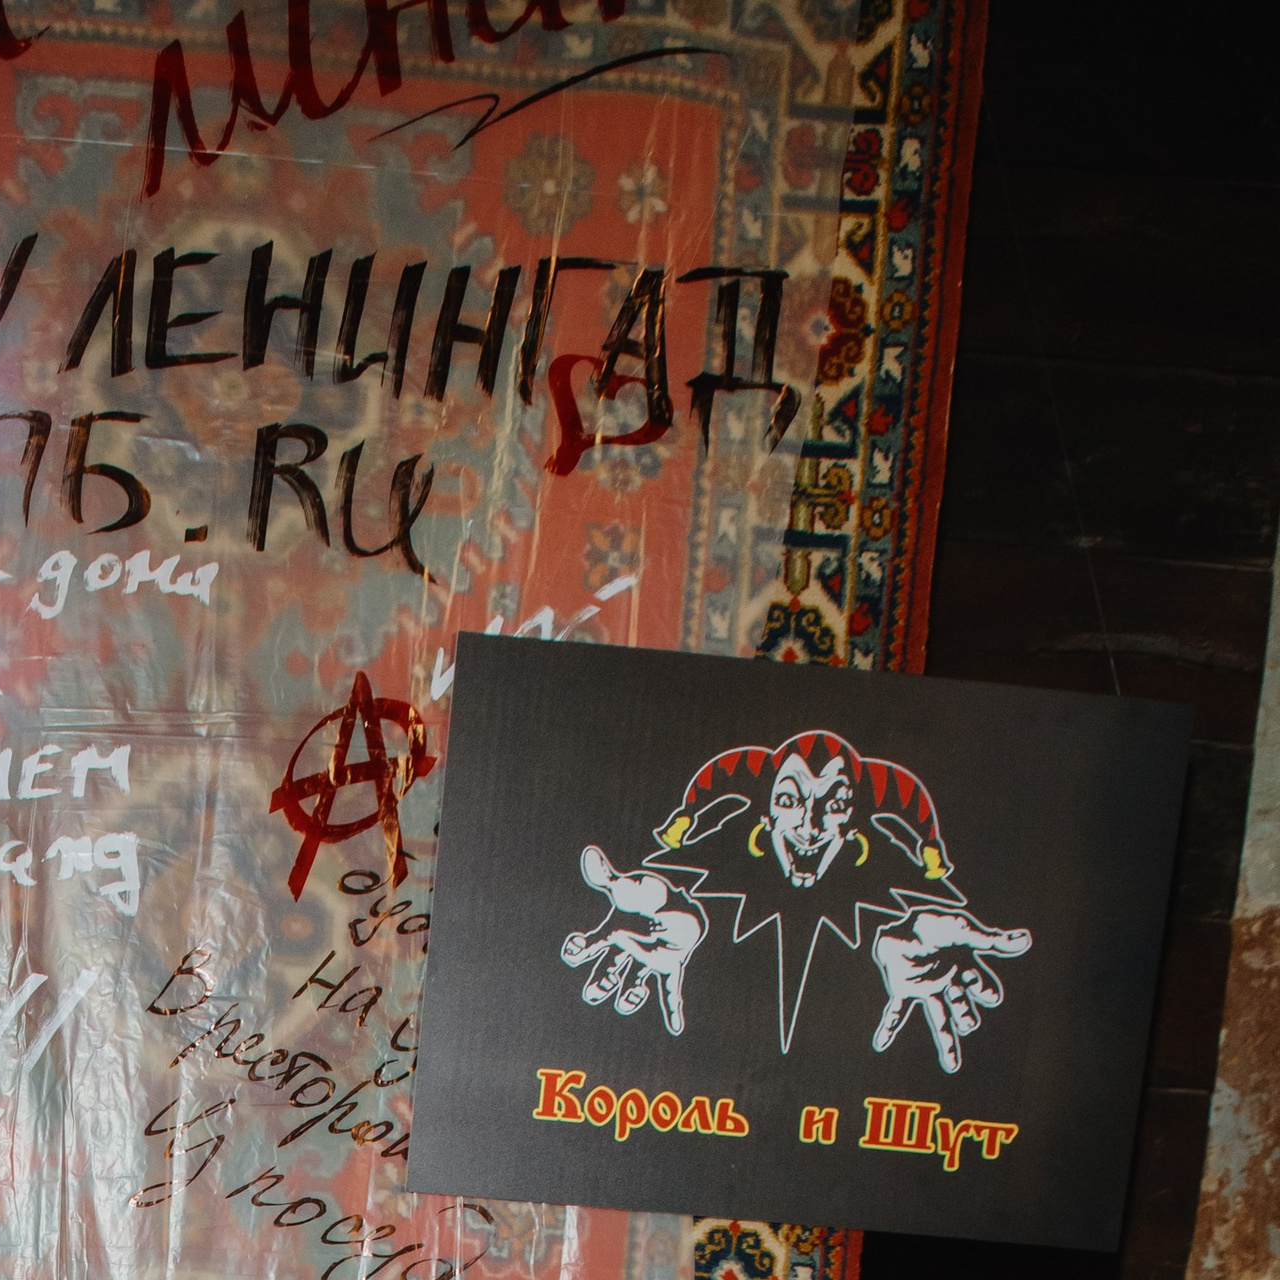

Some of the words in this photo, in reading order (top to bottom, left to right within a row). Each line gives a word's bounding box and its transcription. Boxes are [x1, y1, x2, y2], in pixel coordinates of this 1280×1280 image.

[532, 1068, 750, 1141] Король
[799, 1105, 839, 1144] и
[858, 1096, 1019, 1171] Шут
